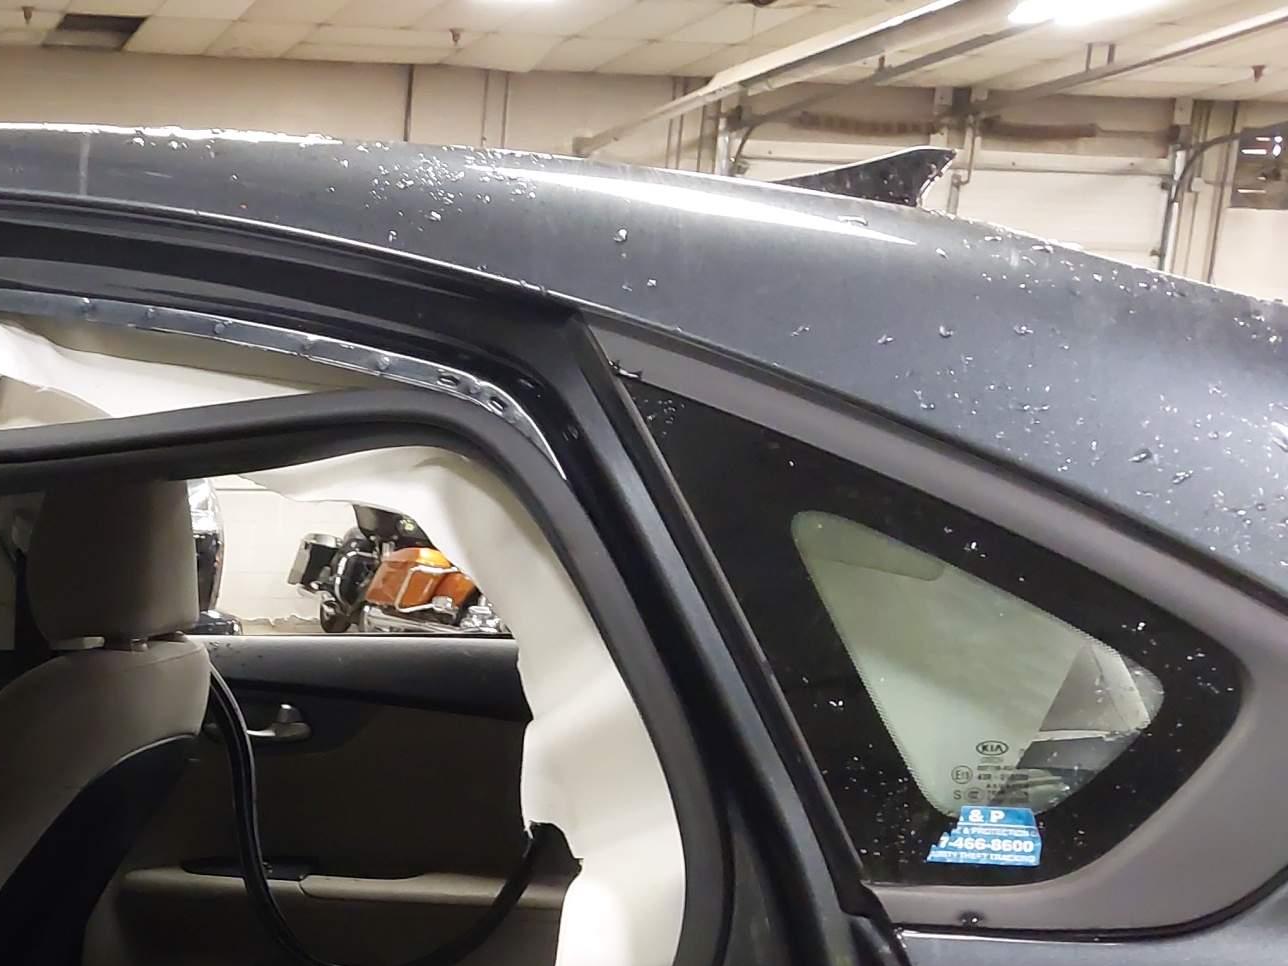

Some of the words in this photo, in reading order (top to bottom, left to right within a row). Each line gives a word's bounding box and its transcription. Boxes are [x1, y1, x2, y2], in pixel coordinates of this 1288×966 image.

[981, 744, 1004, 753] KIA
[969, 809, 984, 822] &
[990, 810, 1005, 823] P
